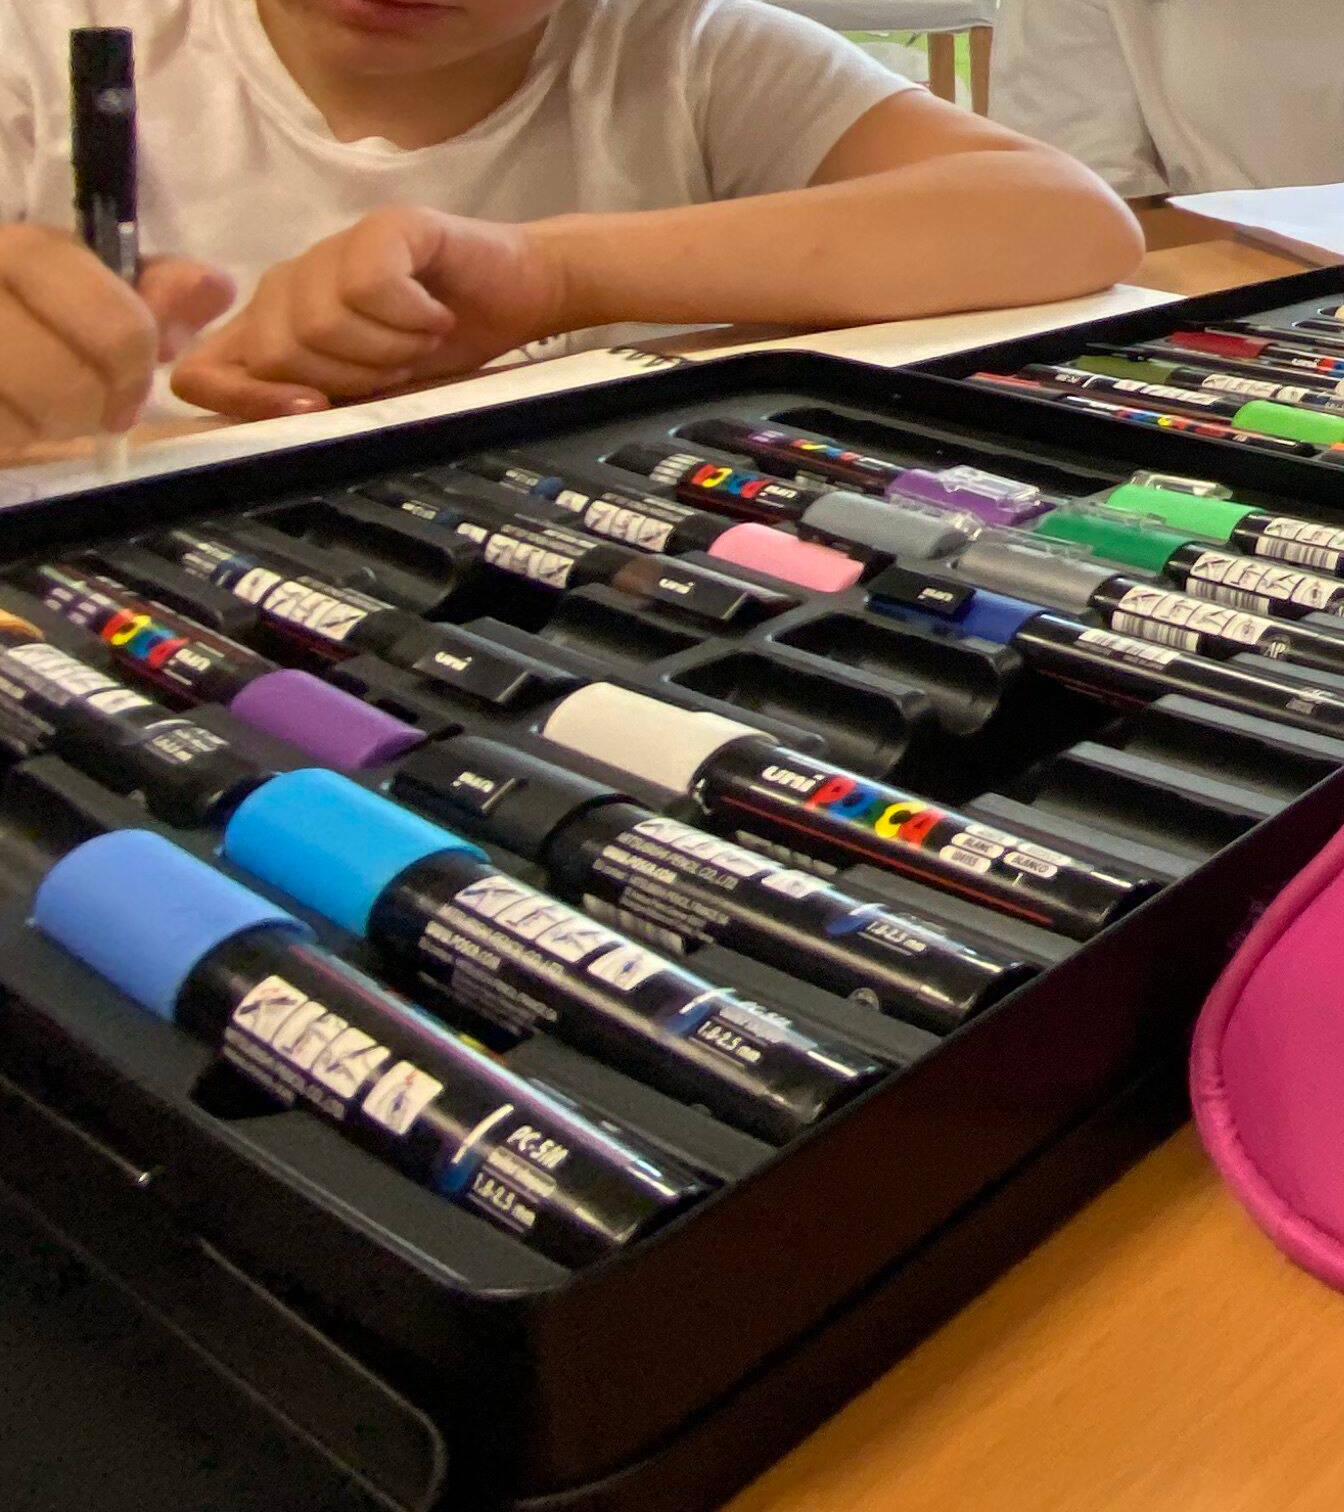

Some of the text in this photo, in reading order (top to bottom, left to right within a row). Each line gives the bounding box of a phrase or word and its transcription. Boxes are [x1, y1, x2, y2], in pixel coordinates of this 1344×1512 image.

[658, 577, 696, 596] uni
[434, 651, 473, 672] uni
[762, 764, 827, 793] uni
[802, 774, 946, 852] POSCA
